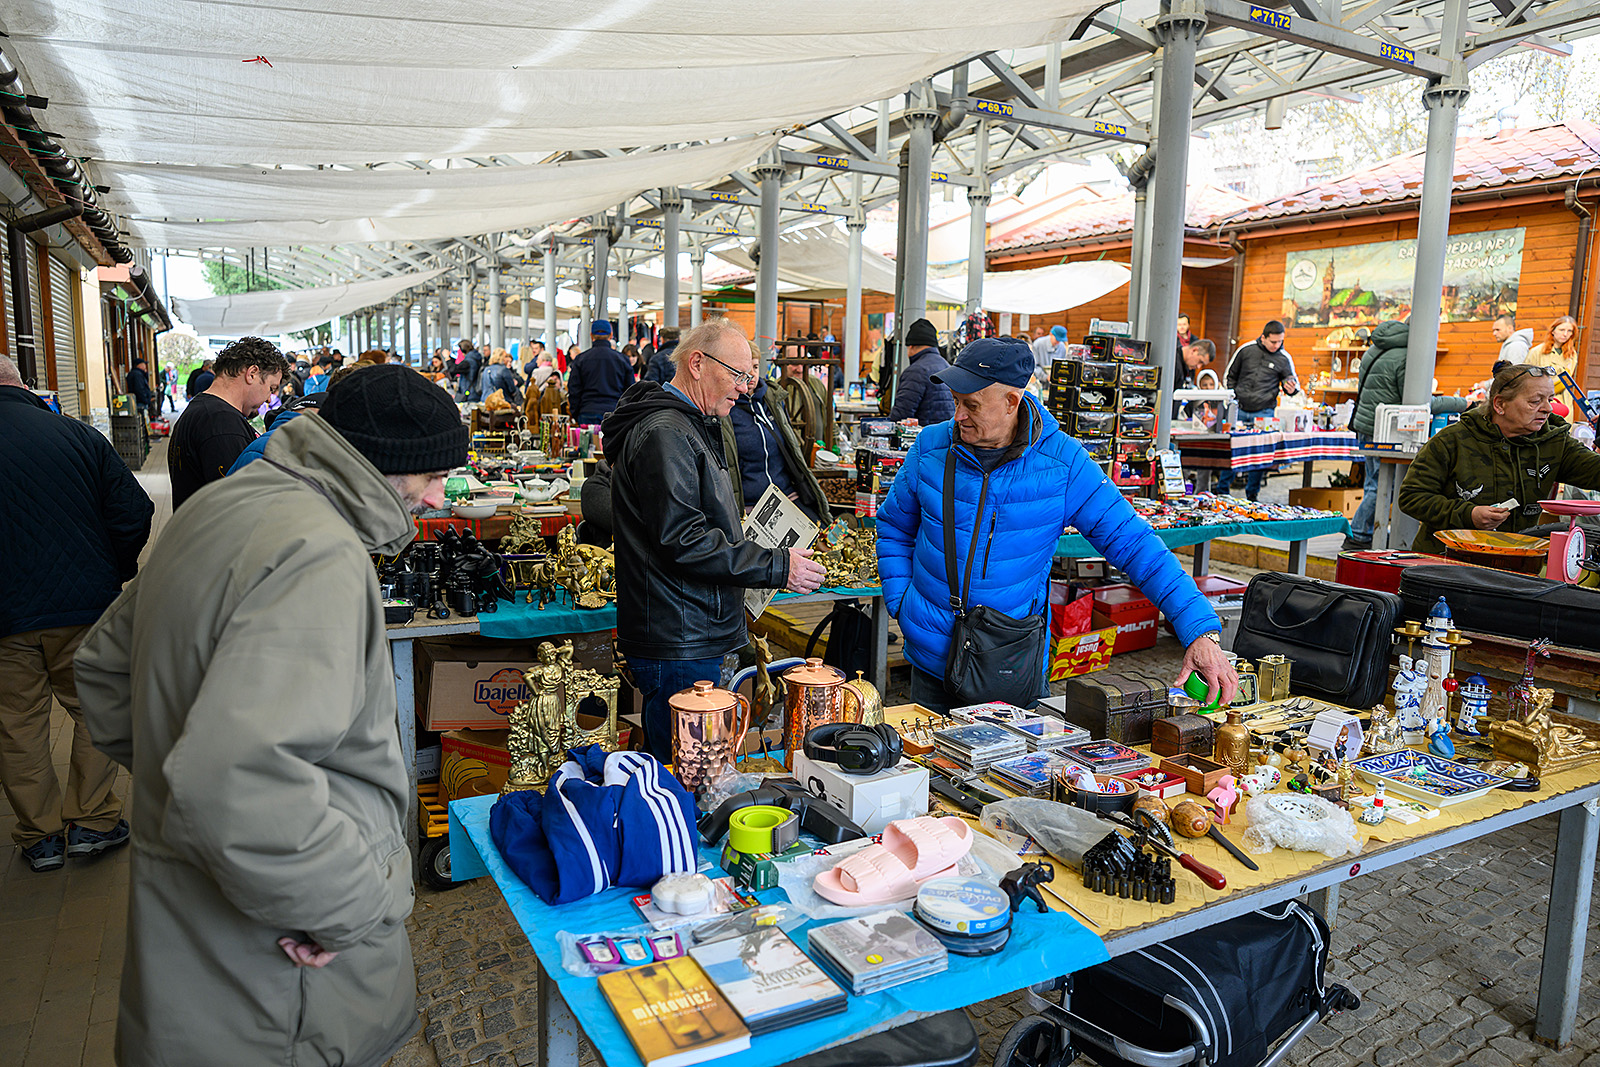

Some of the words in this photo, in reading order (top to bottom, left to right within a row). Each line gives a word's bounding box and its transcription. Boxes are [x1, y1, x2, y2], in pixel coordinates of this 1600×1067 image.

[1262, 10, 1292, 29] 71,72
[1380, 43, 1406, 61] 31,32
[987, 104, 1013, 116] 69,70
[1094, 122, 1117, 135] 29,30
[825, 157, 849, 168] 67,68
[1445, 239, 1483, 255] IEDLA
[1485, 238, 1506, 251] NR
[1508, 236, 1516, 248] 1
[1116, 619, 1155, 635] HILTI
[631, 990, 713, 1021] mirkowicz
